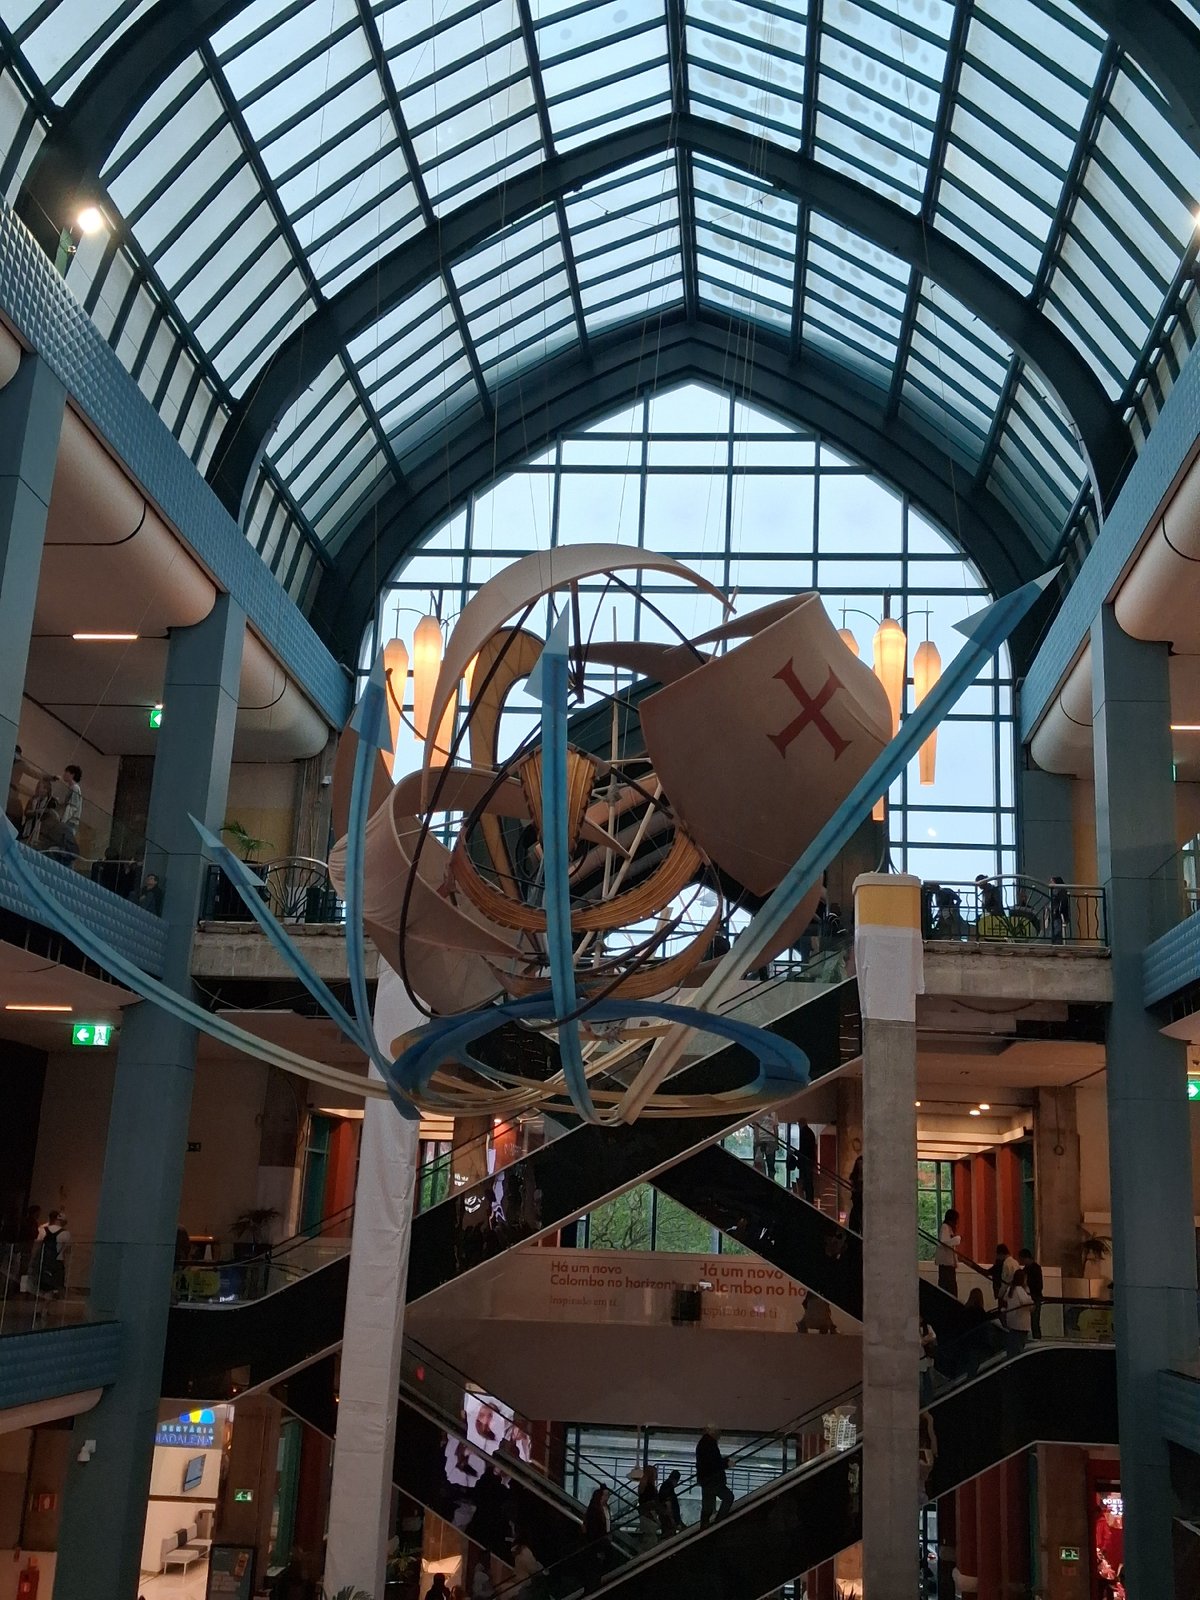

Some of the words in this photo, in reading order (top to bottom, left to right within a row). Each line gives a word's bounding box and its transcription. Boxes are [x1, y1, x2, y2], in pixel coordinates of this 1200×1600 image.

[551, 1260, 569, 1273] Há
[571, 1265, 590, 1274] um
[592, 1266, 622, 1275] novo
[721, 1267, 743, 1278] um
[747, 1268, 784, 1280] novo
[550, 1274, 605, 1288] Colombo
[607, 1279, 622, 1288] no
[766, 1284, 785, 1296] no
